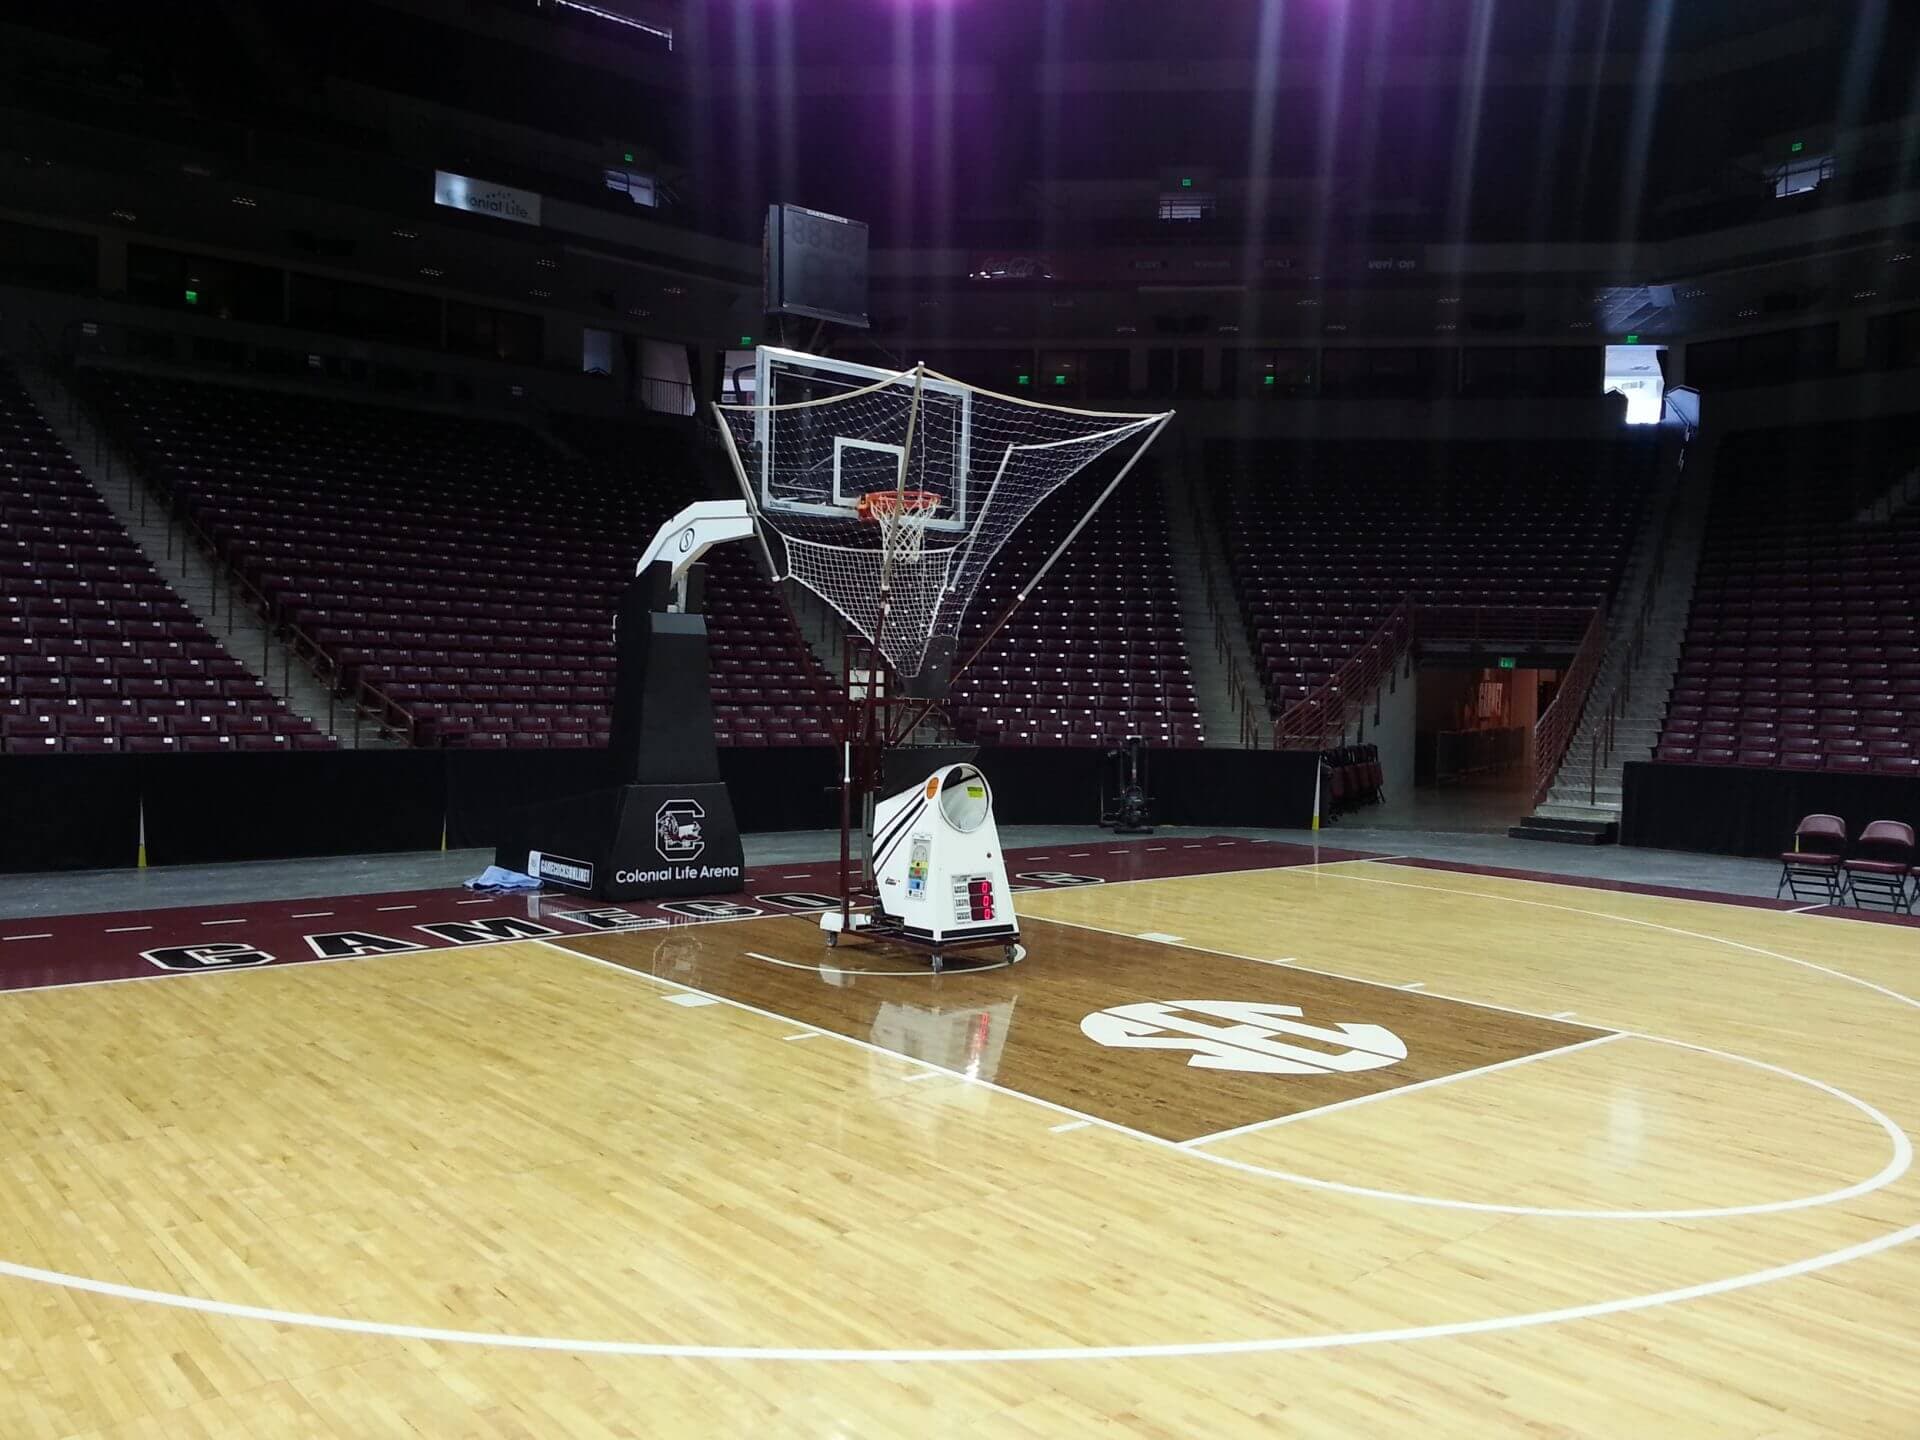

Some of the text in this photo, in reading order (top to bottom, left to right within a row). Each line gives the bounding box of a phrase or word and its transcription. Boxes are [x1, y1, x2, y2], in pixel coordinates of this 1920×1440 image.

[446, 188, 503, 214] Conial
[1367, 256, 1416, 269] verion
[616, 865, 739, 883] Colonial Life Arena
[981, 881, 989, 894] 0
[982, 895, 990, 908] 0
[984, 908, 992, 920] 0
